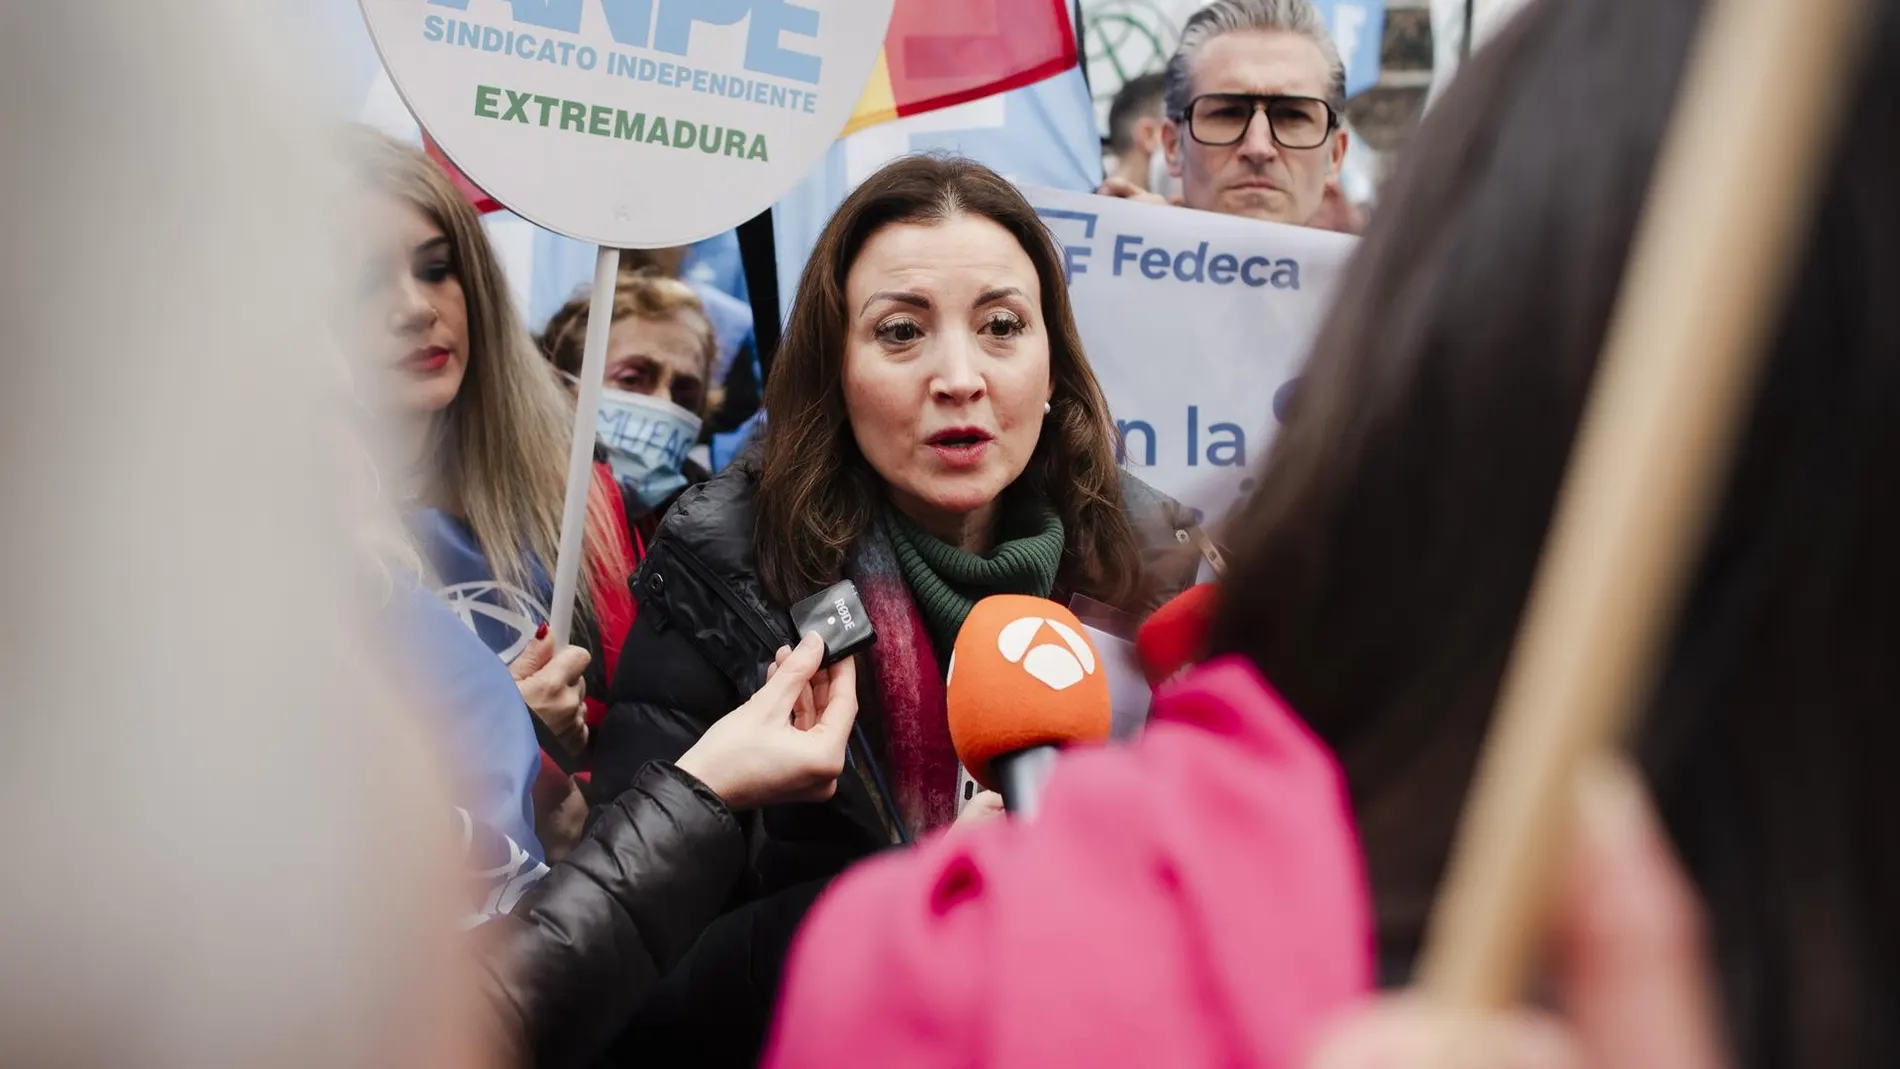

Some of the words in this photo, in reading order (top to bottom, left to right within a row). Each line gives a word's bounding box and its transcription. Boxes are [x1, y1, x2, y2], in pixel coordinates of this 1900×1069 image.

[423, 14, 599, 71] SINDICATO
[606, 52, 819, 114] INDEPENDIENTE
[474, 85, 770, 162] EXTREMADURA
[1112, 233, 1300, 290] Fedeca
[1187, 404, 1247, 467] la
